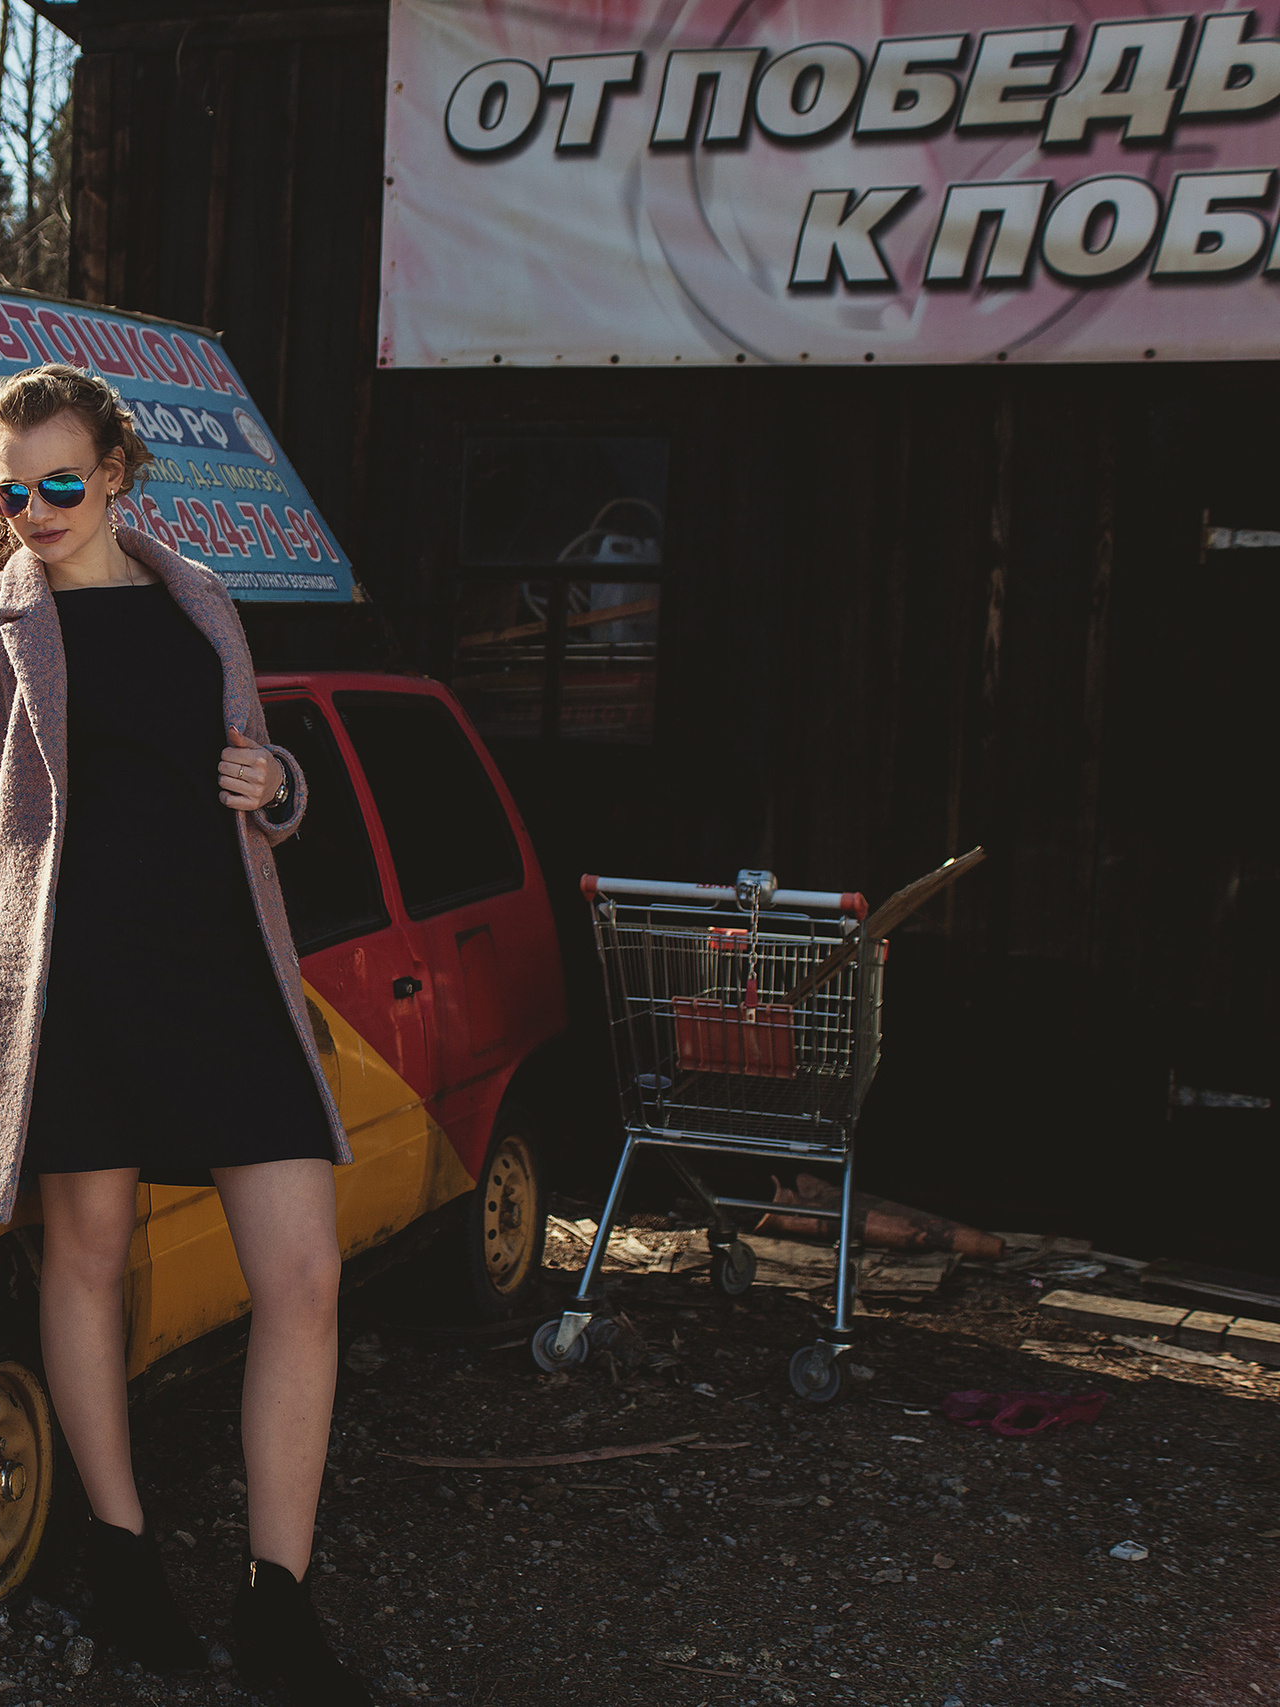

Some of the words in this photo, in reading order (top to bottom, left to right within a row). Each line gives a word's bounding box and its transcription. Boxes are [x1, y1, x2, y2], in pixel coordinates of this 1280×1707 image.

[445, 50, 644, 155] ОТ
[788, 185, 922, 292] К
[923, 168, 1280, 289] ПОБ
[178, 406, 229, 449] РФ
[220, 463, 290, 498] (МОГЭС)
[220, 572, 259, 587] ЫВНОГО
